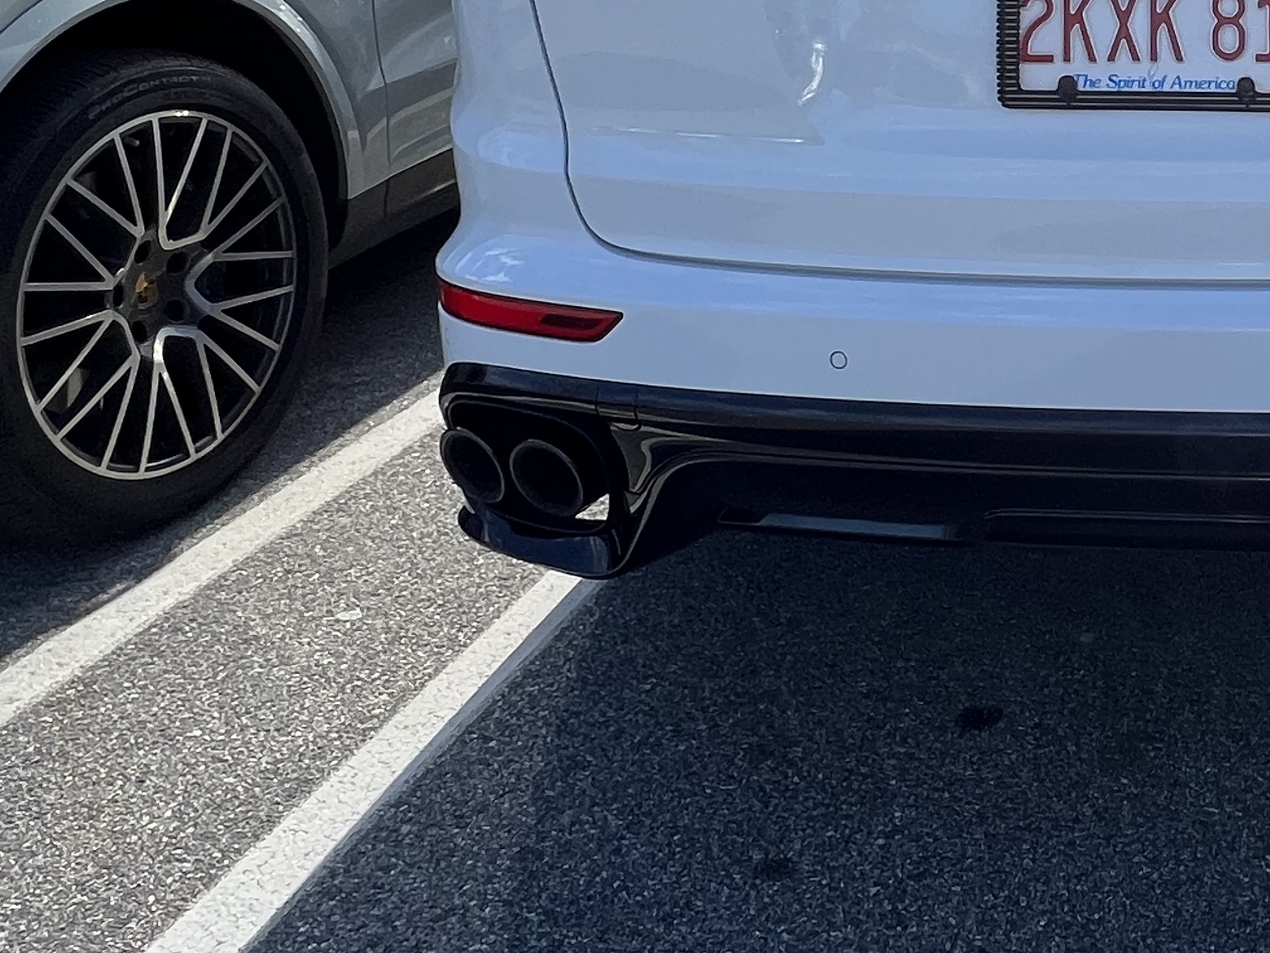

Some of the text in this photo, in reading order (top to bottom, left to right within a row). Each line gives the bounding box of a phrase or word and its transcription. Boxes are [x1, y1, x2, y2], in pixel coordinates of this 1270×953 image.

[1074, 74, 1236, 91] The Spirit of America
